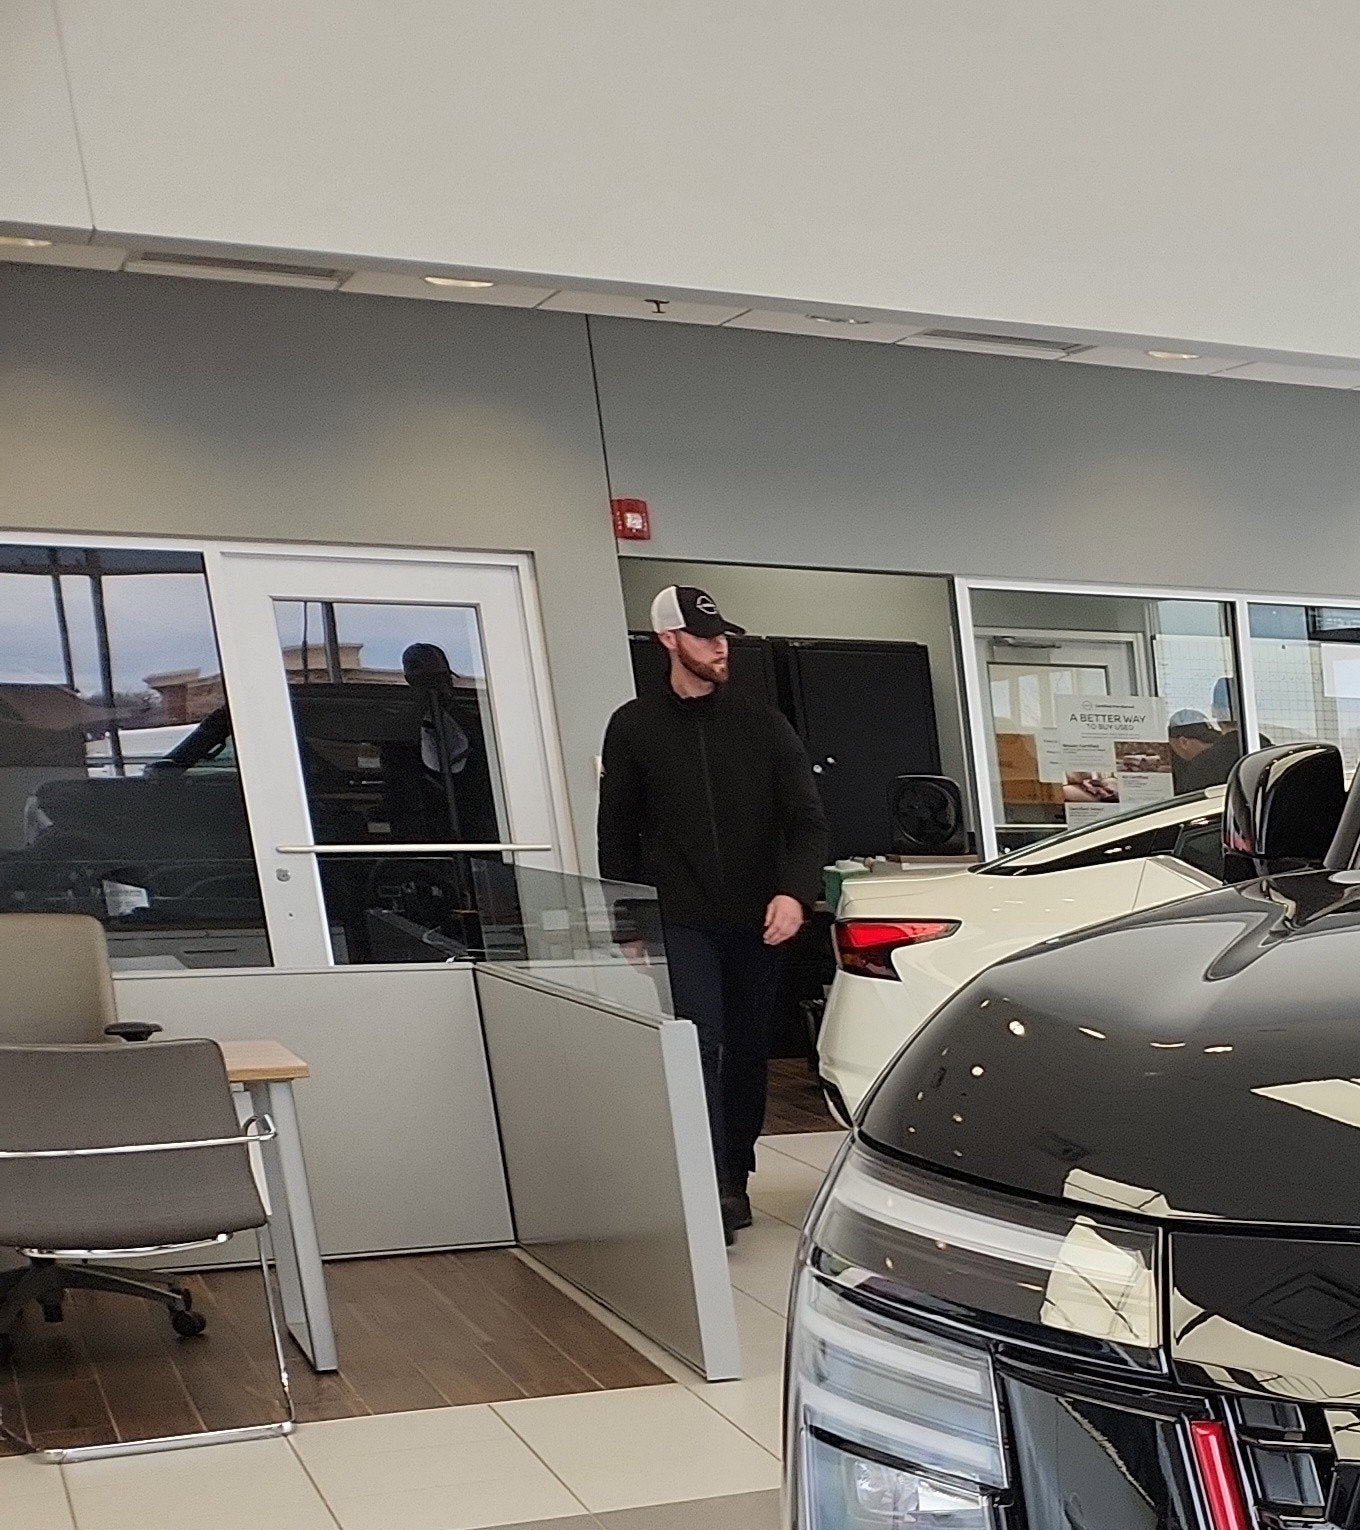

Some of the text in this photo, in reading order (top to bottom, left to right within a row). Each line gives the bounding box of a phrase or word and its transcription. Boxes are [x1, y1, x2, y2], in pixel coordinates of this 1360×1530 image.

[1069, 713, 1146, 724] A BETTER WAY
